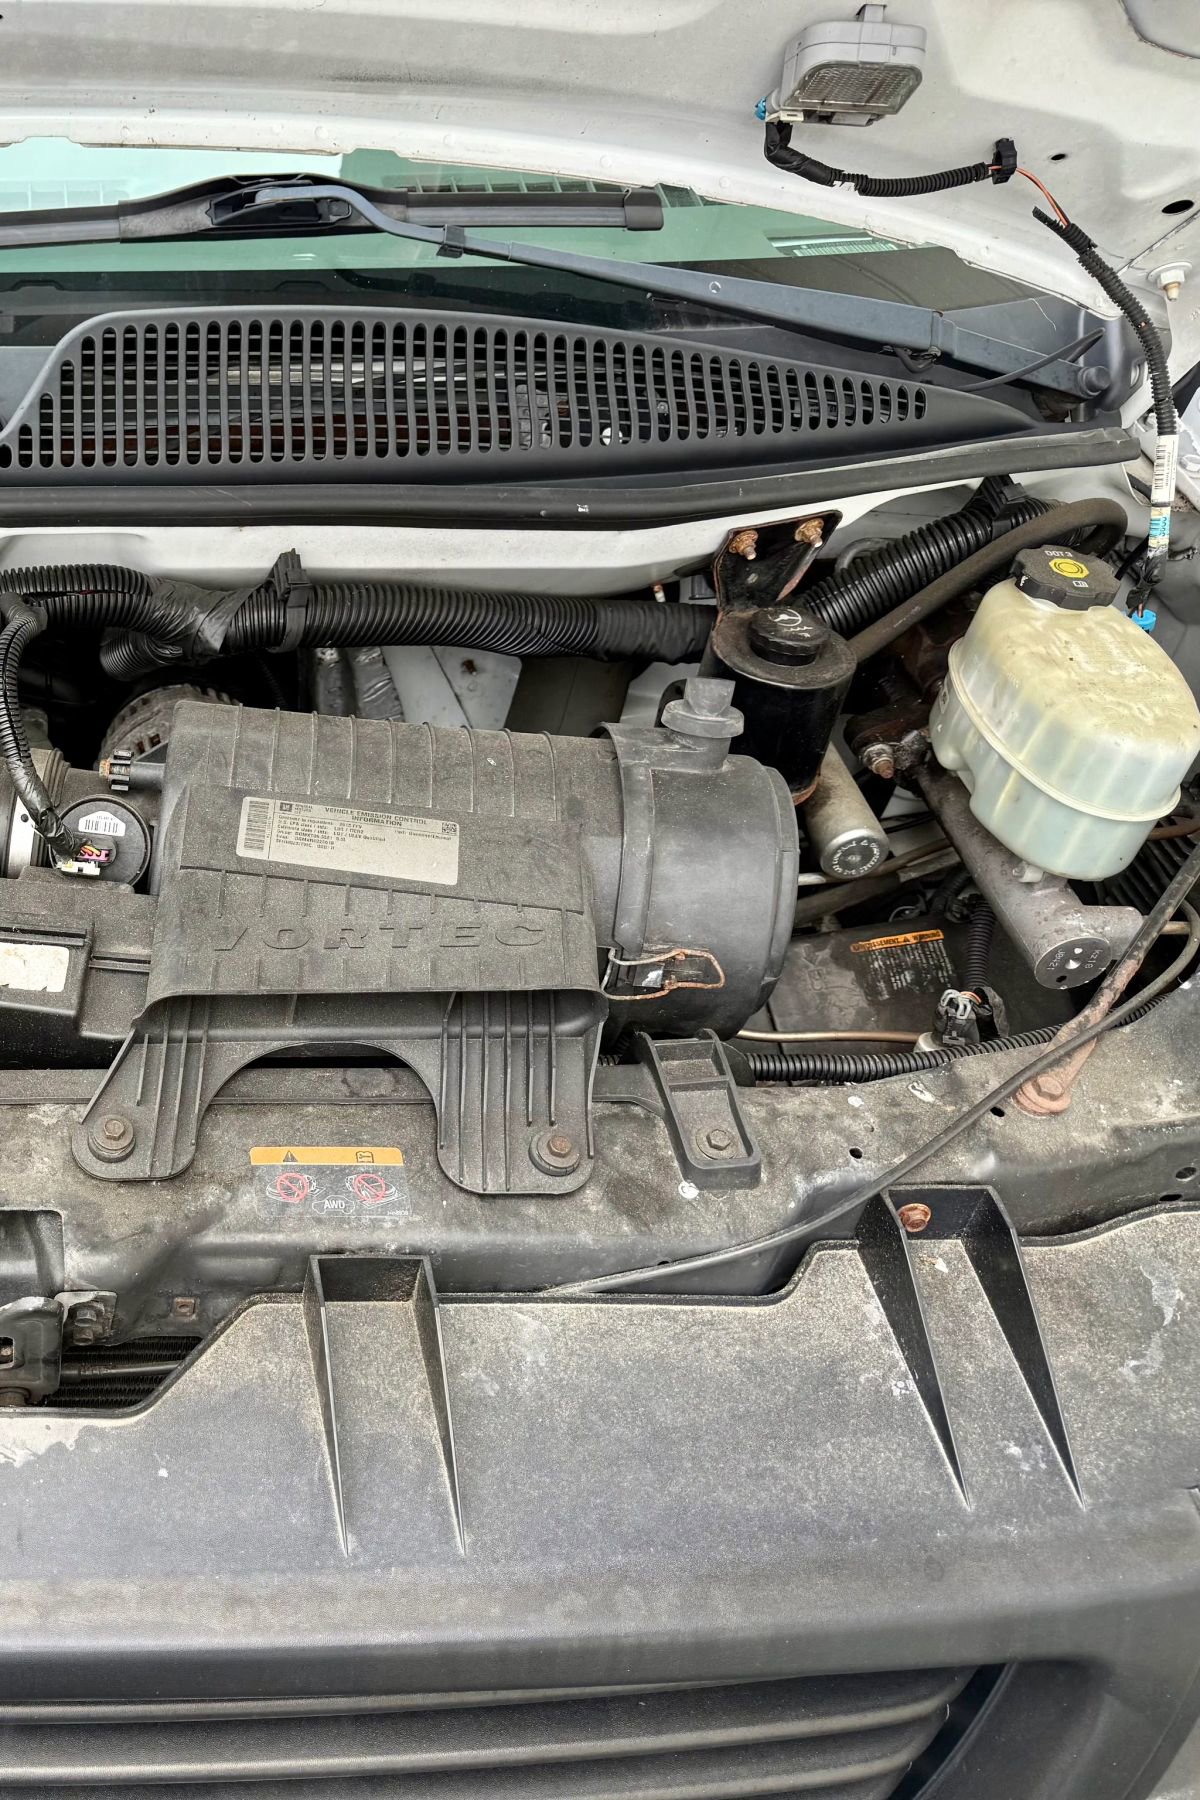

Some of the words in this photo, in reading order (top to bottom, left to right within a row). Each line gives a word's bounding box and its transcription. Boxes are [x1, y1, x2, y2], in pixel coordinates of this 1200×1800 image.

[325, 807, 355, 815] VEHICLE
[356, 811, 392, 820] EMISSION
[394, 815, 427, 825] CONTROL
[351, 815, 402, 827] INFORMATION
[214, 924, 545, 952] VORTEC
[323, 1200, 346, 1209] AWD
